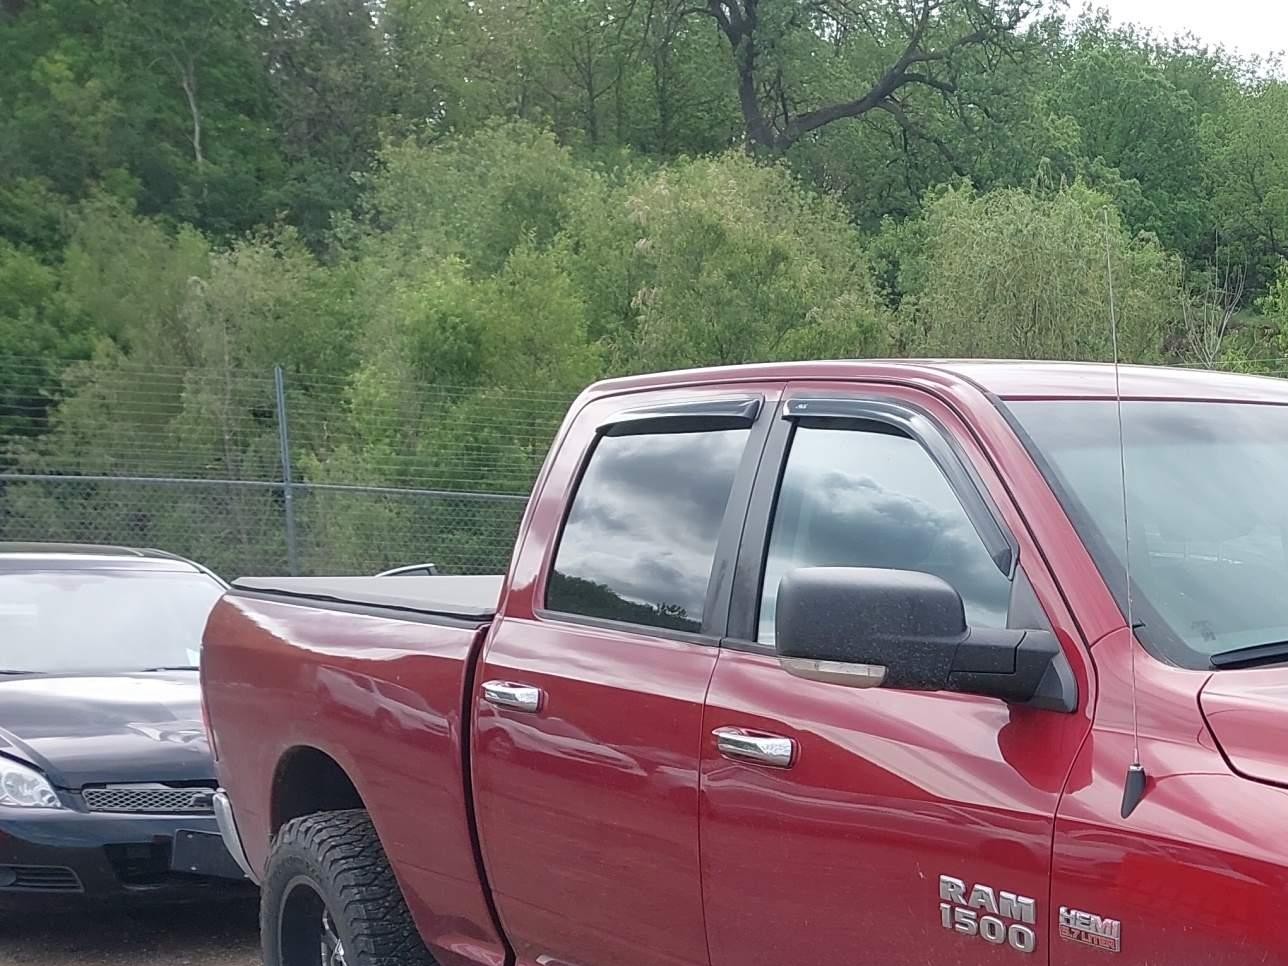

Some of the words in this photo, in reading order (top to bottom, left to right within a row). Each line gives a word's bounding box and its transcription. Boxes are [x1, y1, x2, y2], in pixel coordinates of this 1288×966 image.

[940, 874, 1036, 924] RAM
[1059, 905, 1121, 939] HEMI
[940, 902, 1036, 953] 1500
